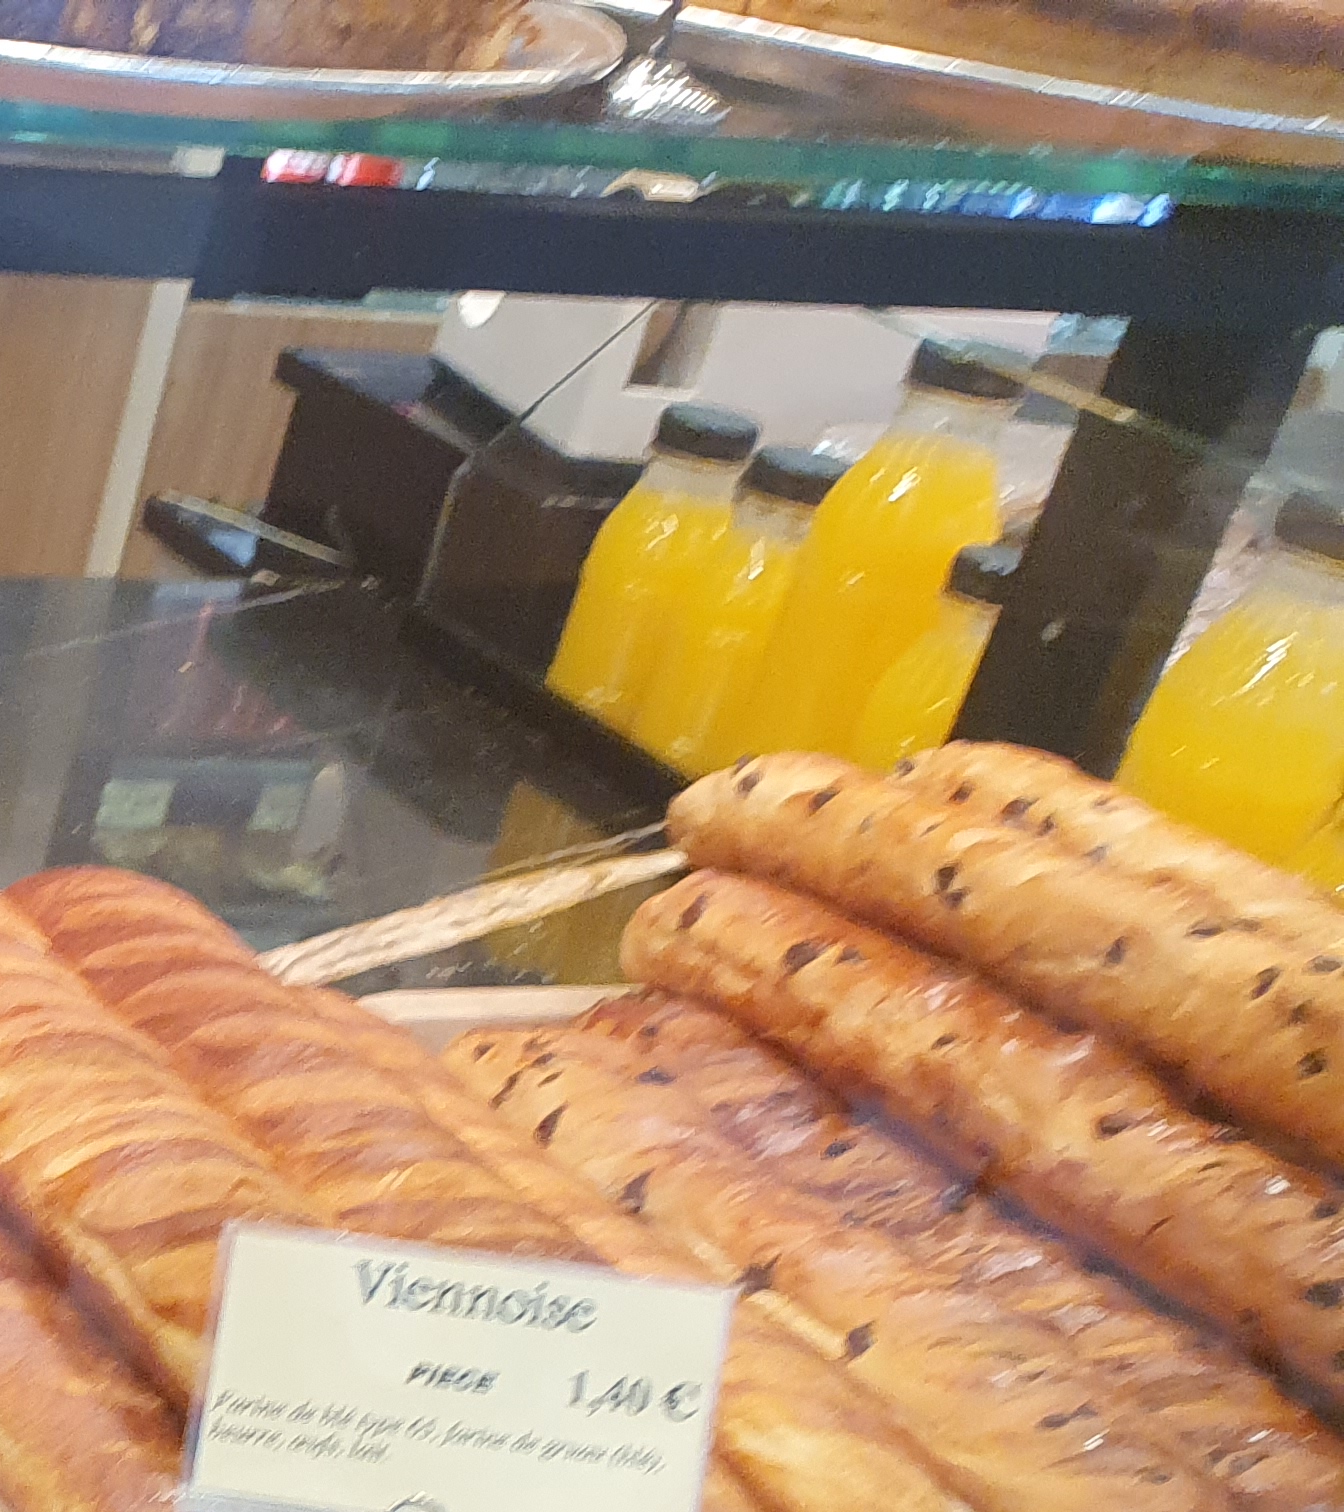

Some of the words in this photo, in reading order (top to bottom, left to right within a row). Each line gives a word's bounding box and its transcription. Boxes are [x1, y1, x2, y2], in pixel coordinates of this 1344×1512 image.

[352, 1259, 598, 1334] Viennoise
[568, 1369, 653, 1417] 1,40
[661, 1381, 703, 1422] €
